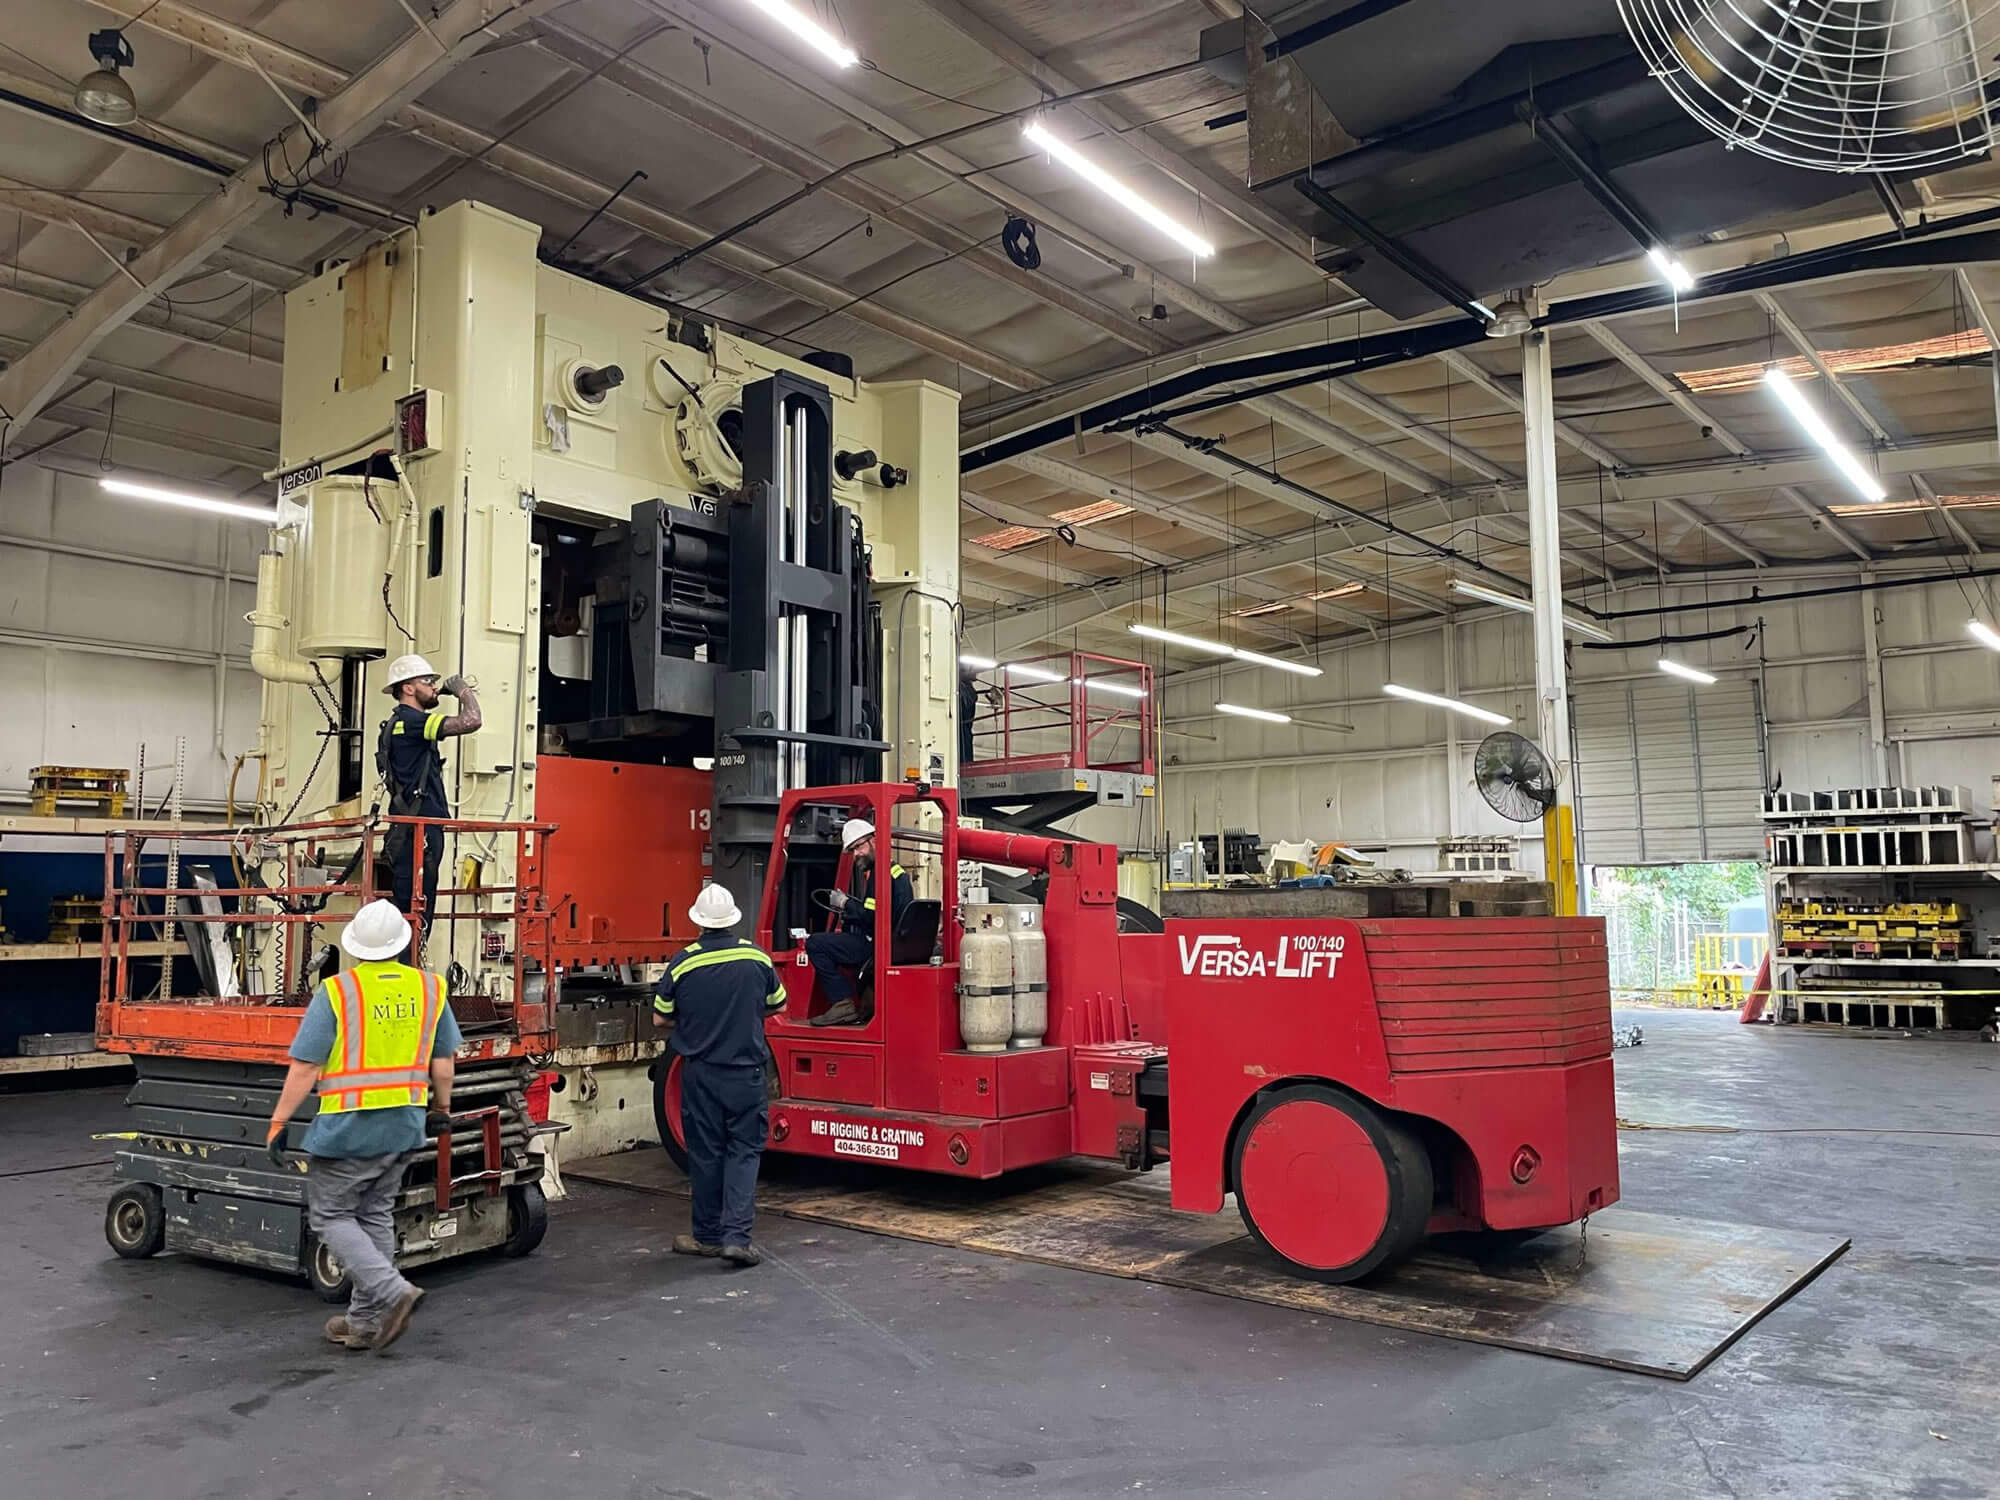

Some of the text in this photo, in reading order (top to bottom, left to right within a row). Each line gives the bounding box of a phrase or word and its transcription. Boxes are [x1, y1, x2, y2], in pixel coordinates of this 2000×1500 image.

[280, 465, 321, 495] Verson
[719, 754, 746, 767] 100/140
[689, 809, 712, 830] 13
[1293, 936, 1345, 951] 100/140
[373, 1003, 416, 1019] MEI
[811, 1120, 925, 1147] MEI RIGGING & CRATING
[837, 1142, 897, 1157] 404-366-2511
